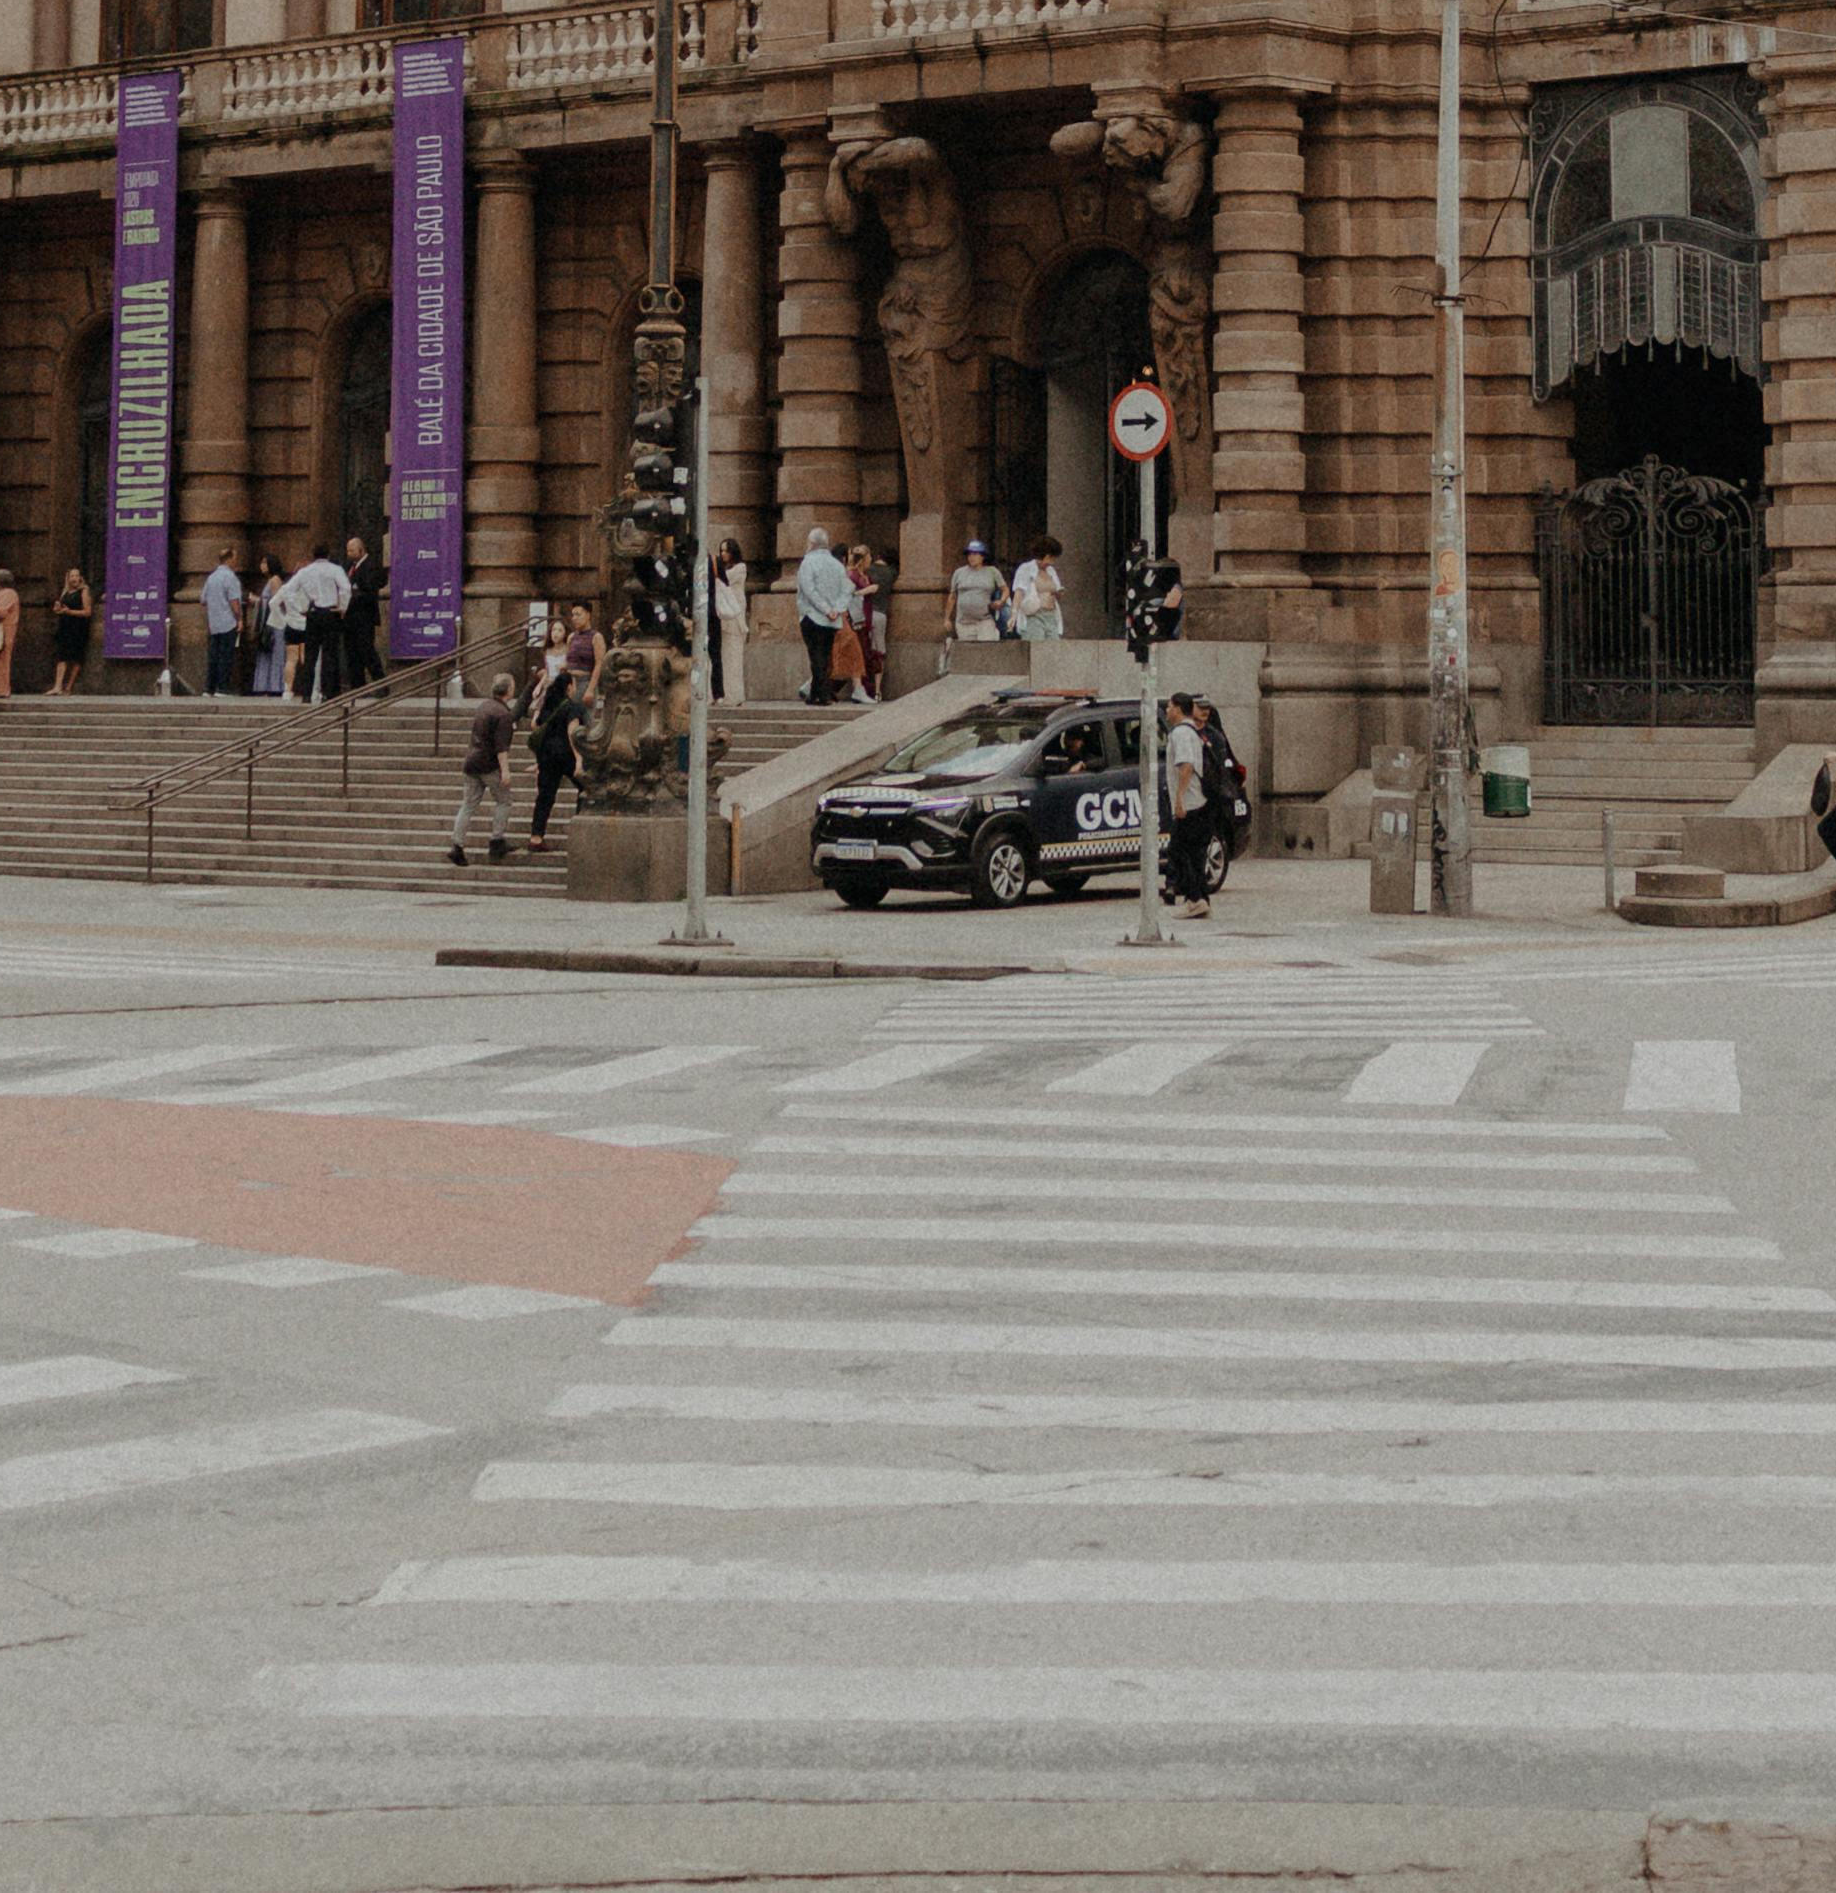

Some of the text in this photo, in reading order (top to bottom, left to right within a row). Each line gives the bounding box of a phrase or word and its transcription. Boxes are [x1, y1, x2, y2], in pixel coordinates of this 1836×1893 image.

[415, 134, 443, 199] PAULO
[414, 206, 444, 245] SÃO
[417, 250, 445, 277] DE
[417, 282, 445, 357] CIDADE
[417, 363, 444, 391] DA
[115, 278, 171, 527] ENCRUZILHADA
[415, 398, 444, 446] BALÉ
